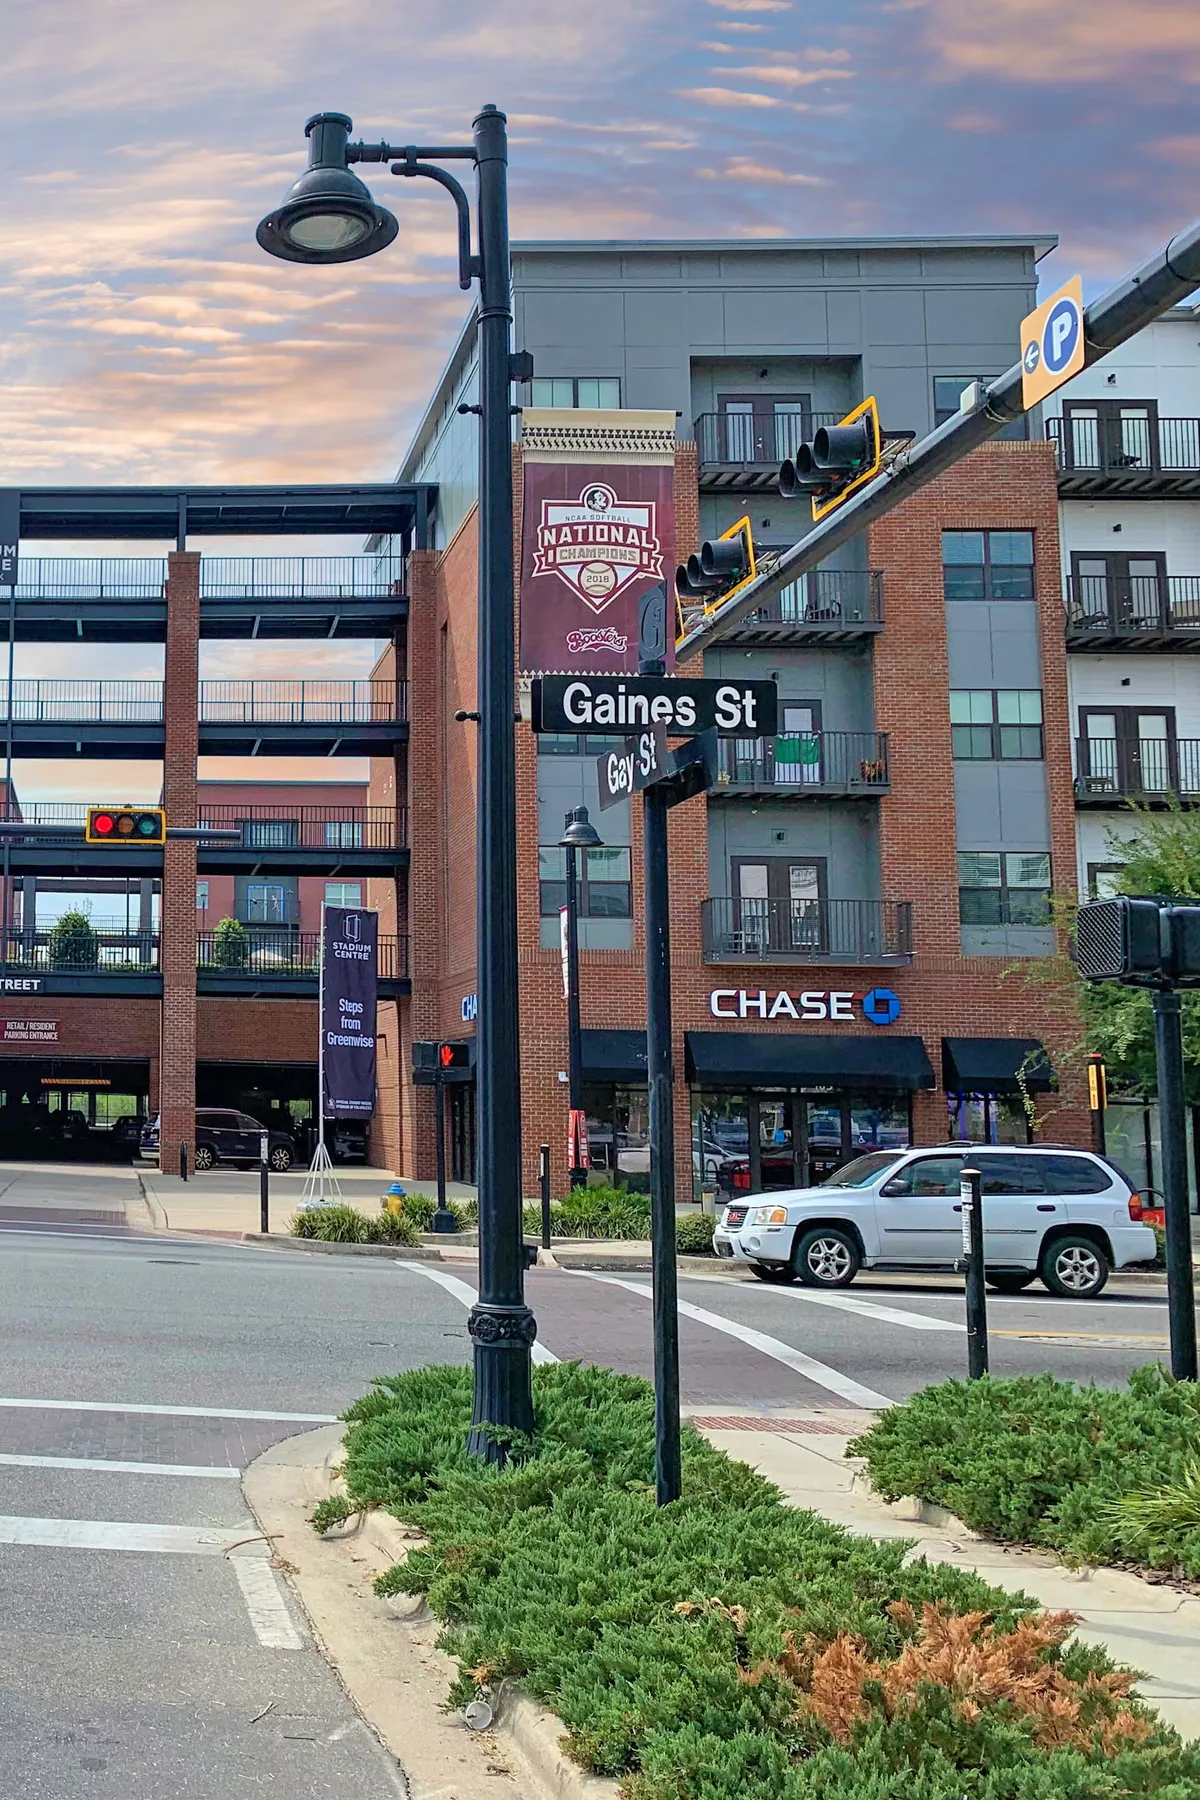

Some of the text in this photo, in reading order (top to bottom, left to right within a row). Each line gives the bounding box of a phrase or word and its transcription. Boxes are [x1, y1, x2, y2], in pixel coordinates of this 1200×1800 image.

[1052, 311, 1073, 362] P
[565, 513, 631, 523] NCAA SOFTBALL
[543, 524, 654, 548] NATIONAL
[558, 548, 637, 562] CHAMPIONS
[586, 575, 610, 583] 2018
[567, 627, 627, 651] Boosters
[563, 682, 757, 728] Gaines St
[607, 732, 657, 794] Gay St
[332, 942, 371, 952] STADIUM
[334, 950, 369, 960] CENTRE
[339, 998, 364, 1015] Steps
[462, 994, 478, 1021] CHA
[710, 989, 856, 1020] CHASE
[6, 1021, 25, 1030] RETAIL
[29, 1022, 57, 1031] RESIDENT
[340, 1015, 361, 1030] from
[4, 1031, 29, 1039] PARKING
[29, 1031, 58, 1040] ENTRANCE
[327, 1031, 374, 1048] Greenwise
